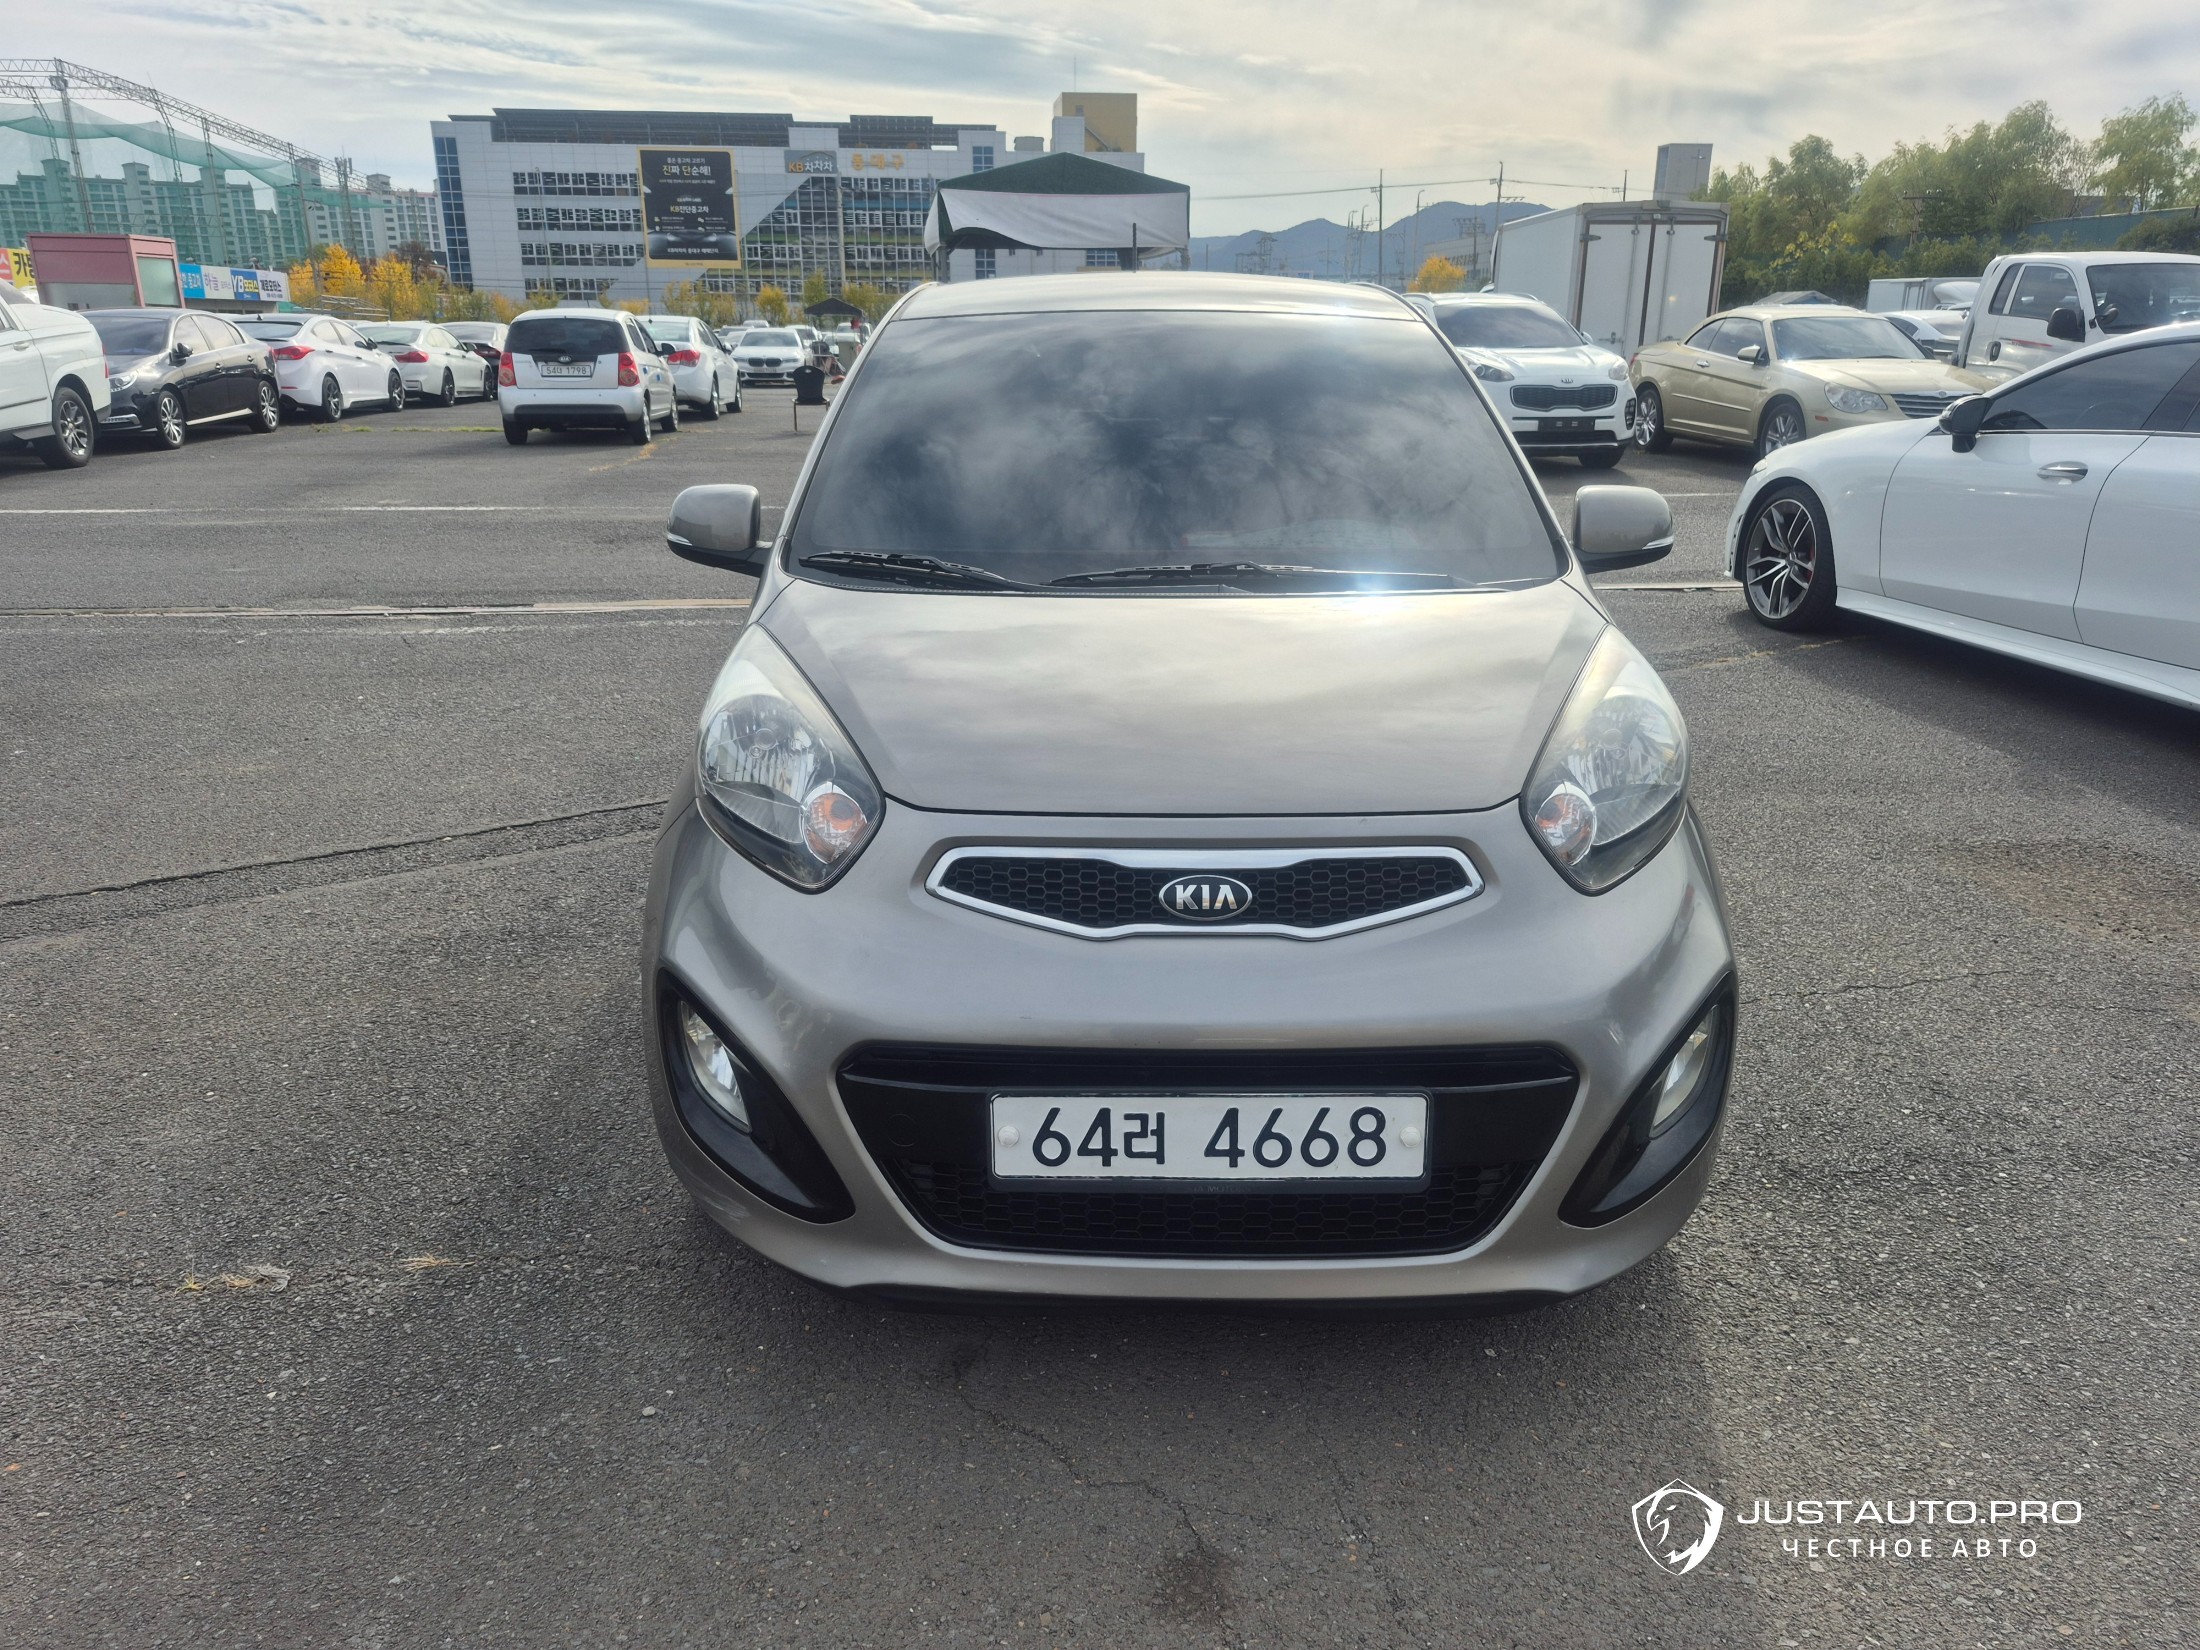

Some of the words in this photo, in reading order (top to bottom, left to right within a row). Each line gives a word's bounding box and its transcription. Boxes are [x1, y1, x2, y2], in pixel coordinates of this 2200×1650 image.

[662, 165, 680, 176] 진짜
[788, 156, 833, 173] KB차차차
[566, 366, 587, 375] 1798
[1175, 884, 1238, 910] KIA
[1032, 1107, 1165, 1167] 64러
[1203, 1106, 1387, 1168] 4668
